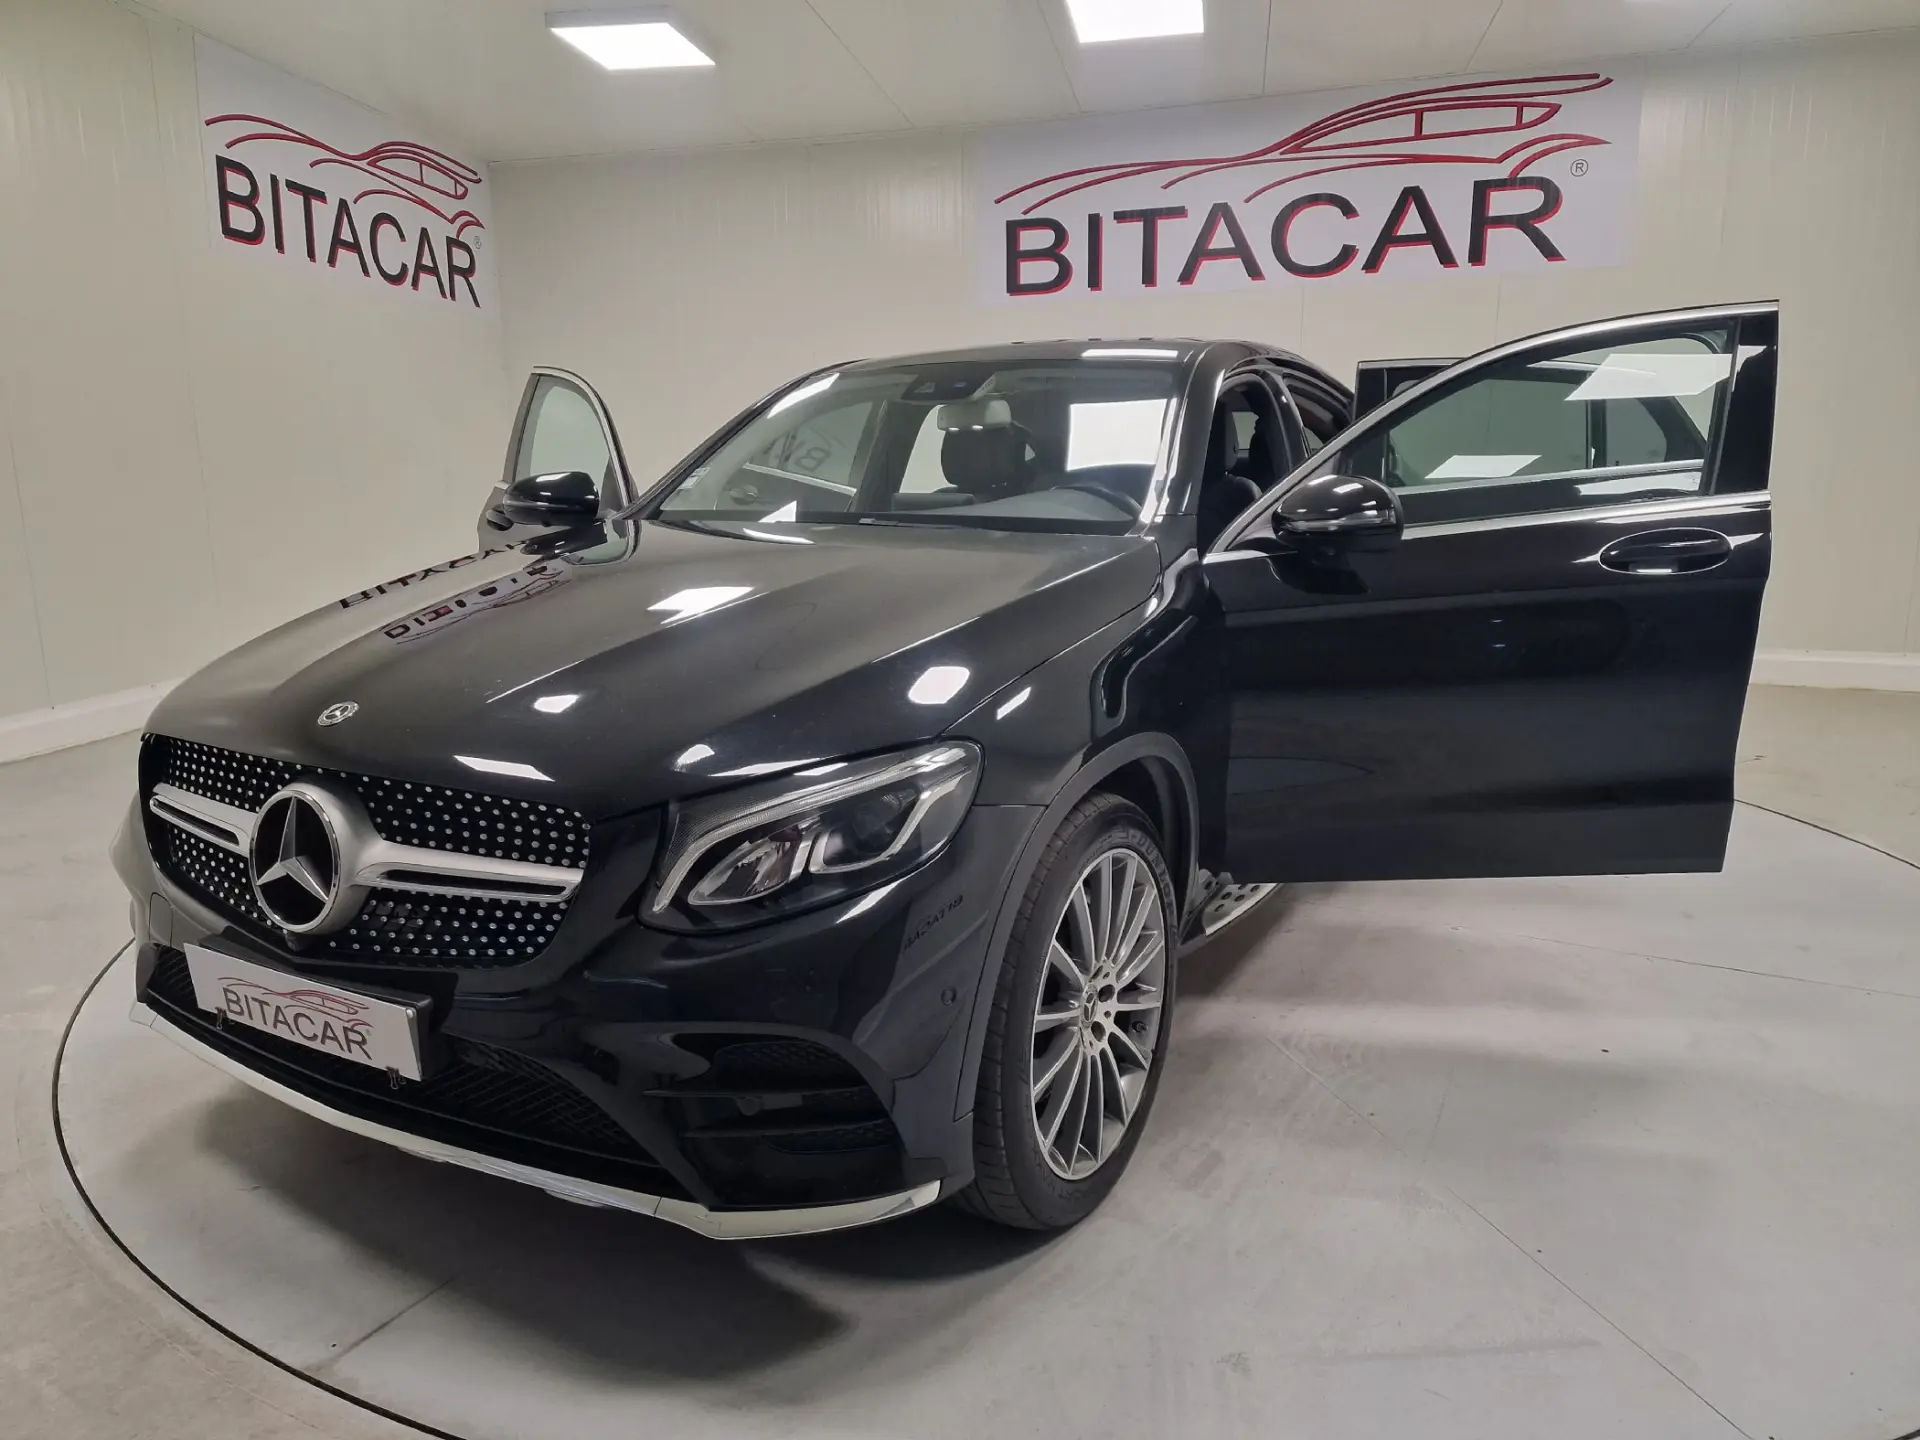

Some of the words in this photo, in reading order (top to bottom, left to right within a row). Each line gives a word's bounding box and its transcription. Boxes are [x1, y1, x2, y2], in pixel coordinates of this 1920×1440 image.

[215, 154, 481, 308] BITACAR
[1006, 176, 1566, 297] BITACAR
[222, 987, 372, 1061] BITACAR
